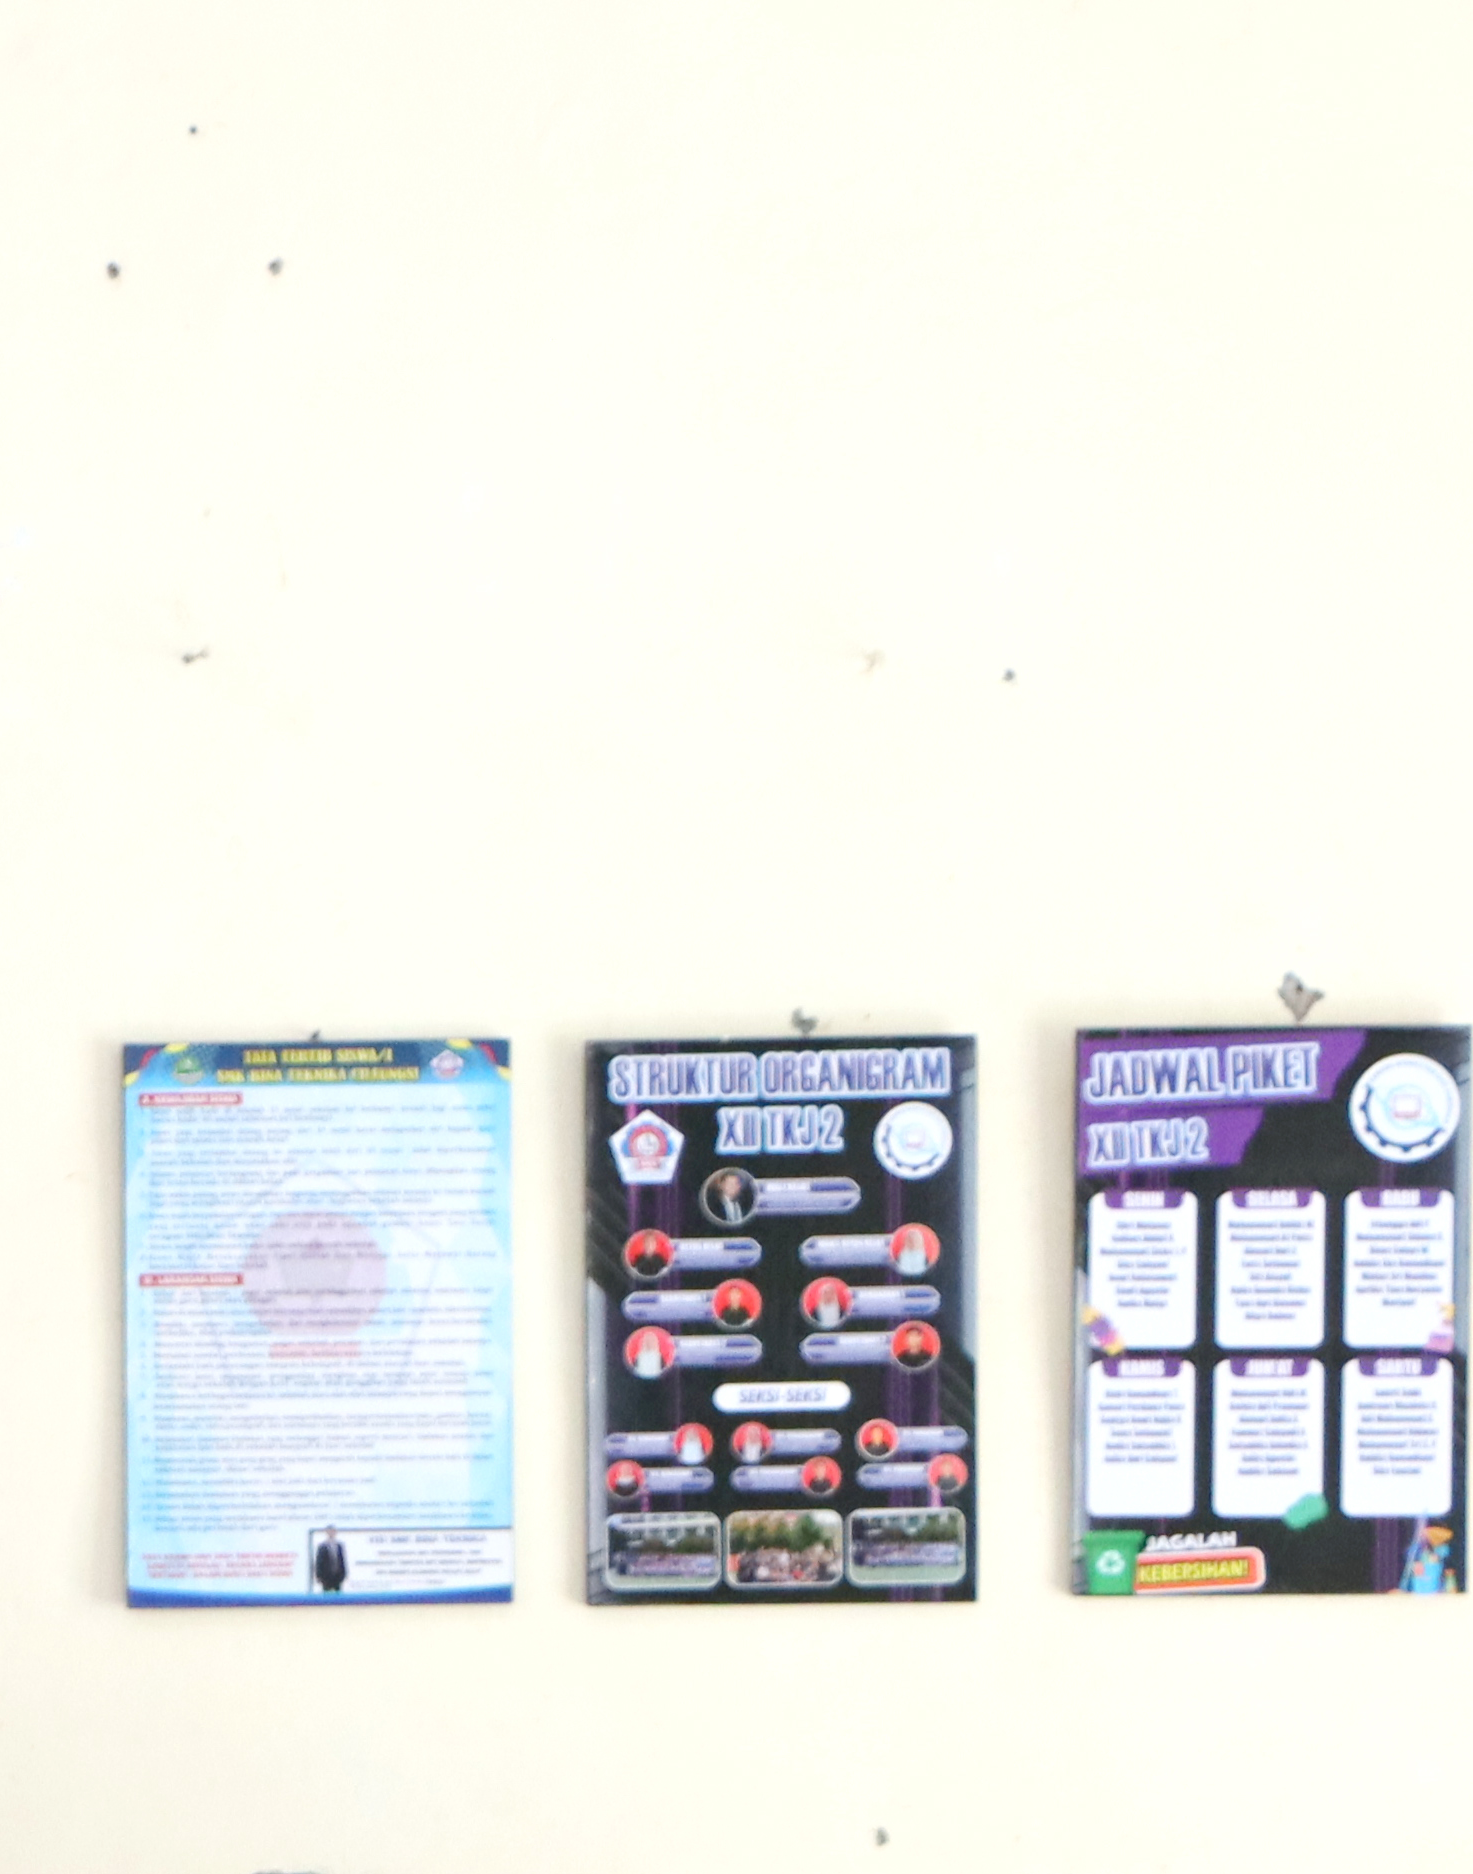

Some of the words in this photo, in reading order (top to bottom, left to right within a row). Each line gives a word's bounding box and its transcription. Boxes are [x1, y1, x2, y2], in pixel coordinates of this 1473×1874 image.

[610, 1054, 758, 1100] STRUKTUR
[761, 1048, 950, 1096] ORGANIGRAM
[1086, 1048, 1224, 1100] JADWAL
[1226, 1042, 1320, 1095] PIKET
